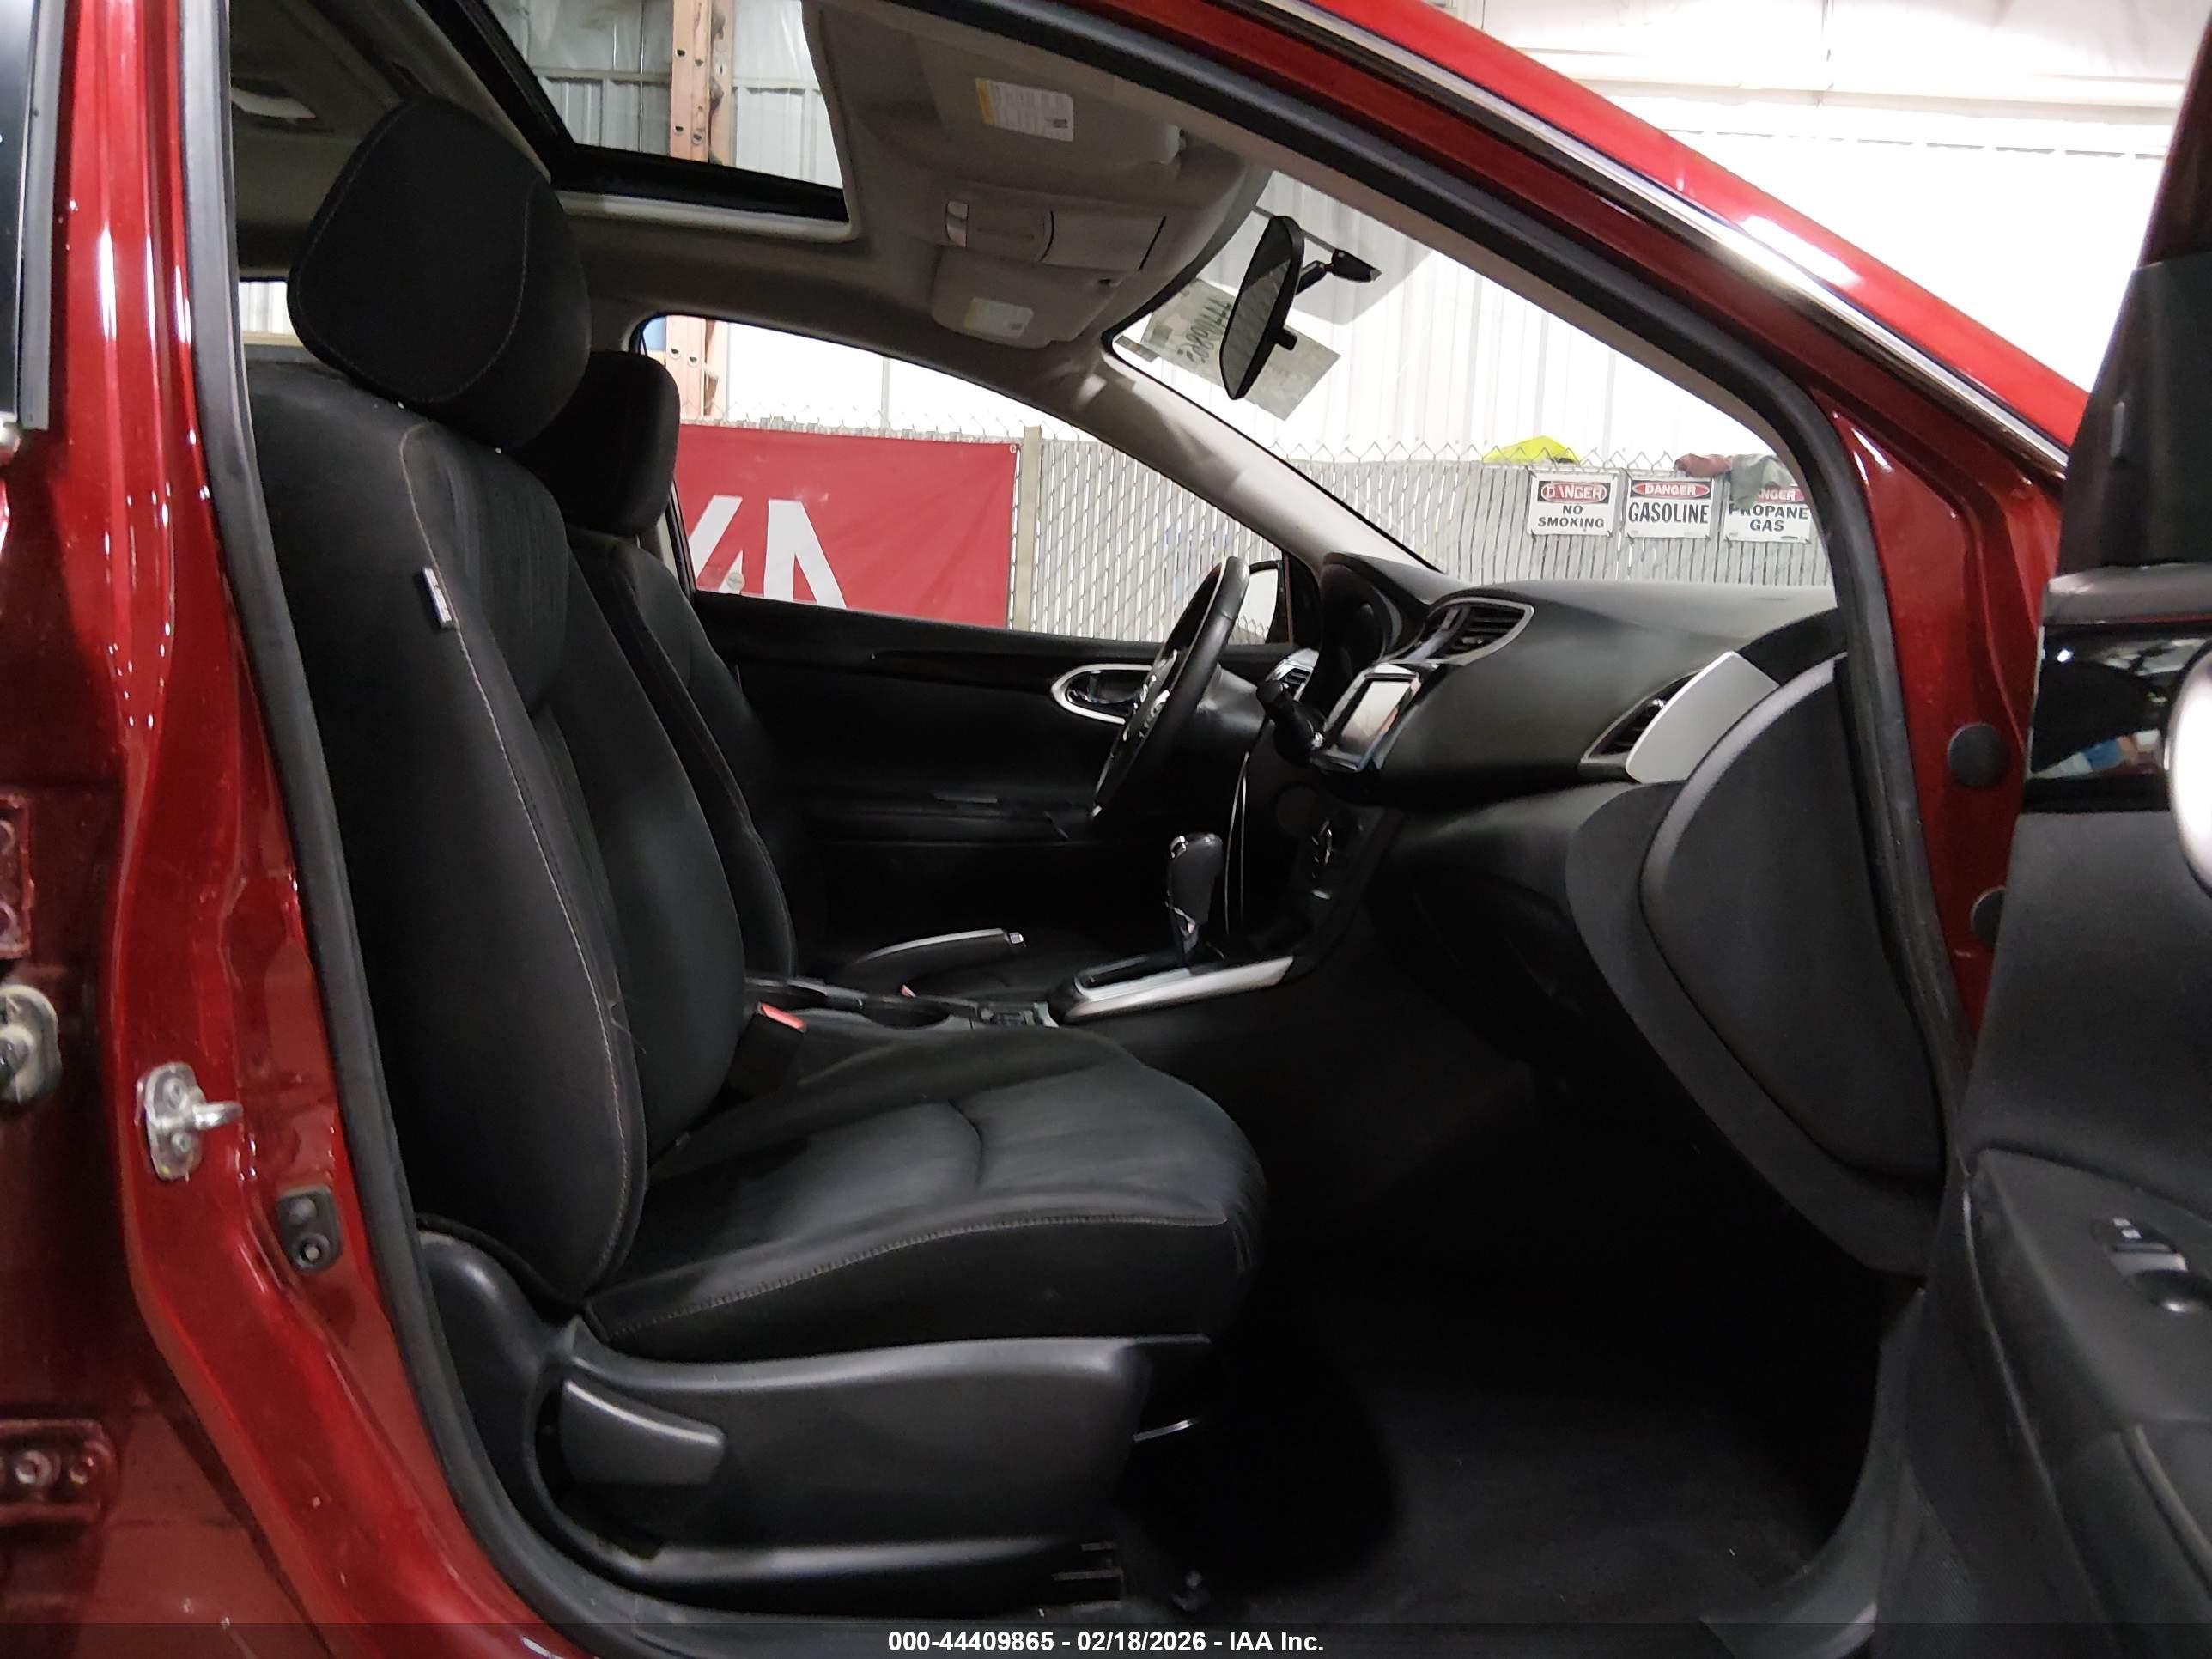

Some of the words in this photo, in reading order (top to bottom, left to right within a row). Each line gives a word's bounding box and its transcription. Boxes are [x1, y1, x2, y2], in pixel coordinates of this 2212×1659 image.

[1644, 483, 1697, 495] DANGER
[1758, 487, 1796, 501] NGER
[1562, 505, 1583, 515] NO
[1628, 501, 1710, 524] GASOLINE
[1538, 517, 1604, 528] SMOKING
[1749, 519, 1784, 532] GAS
